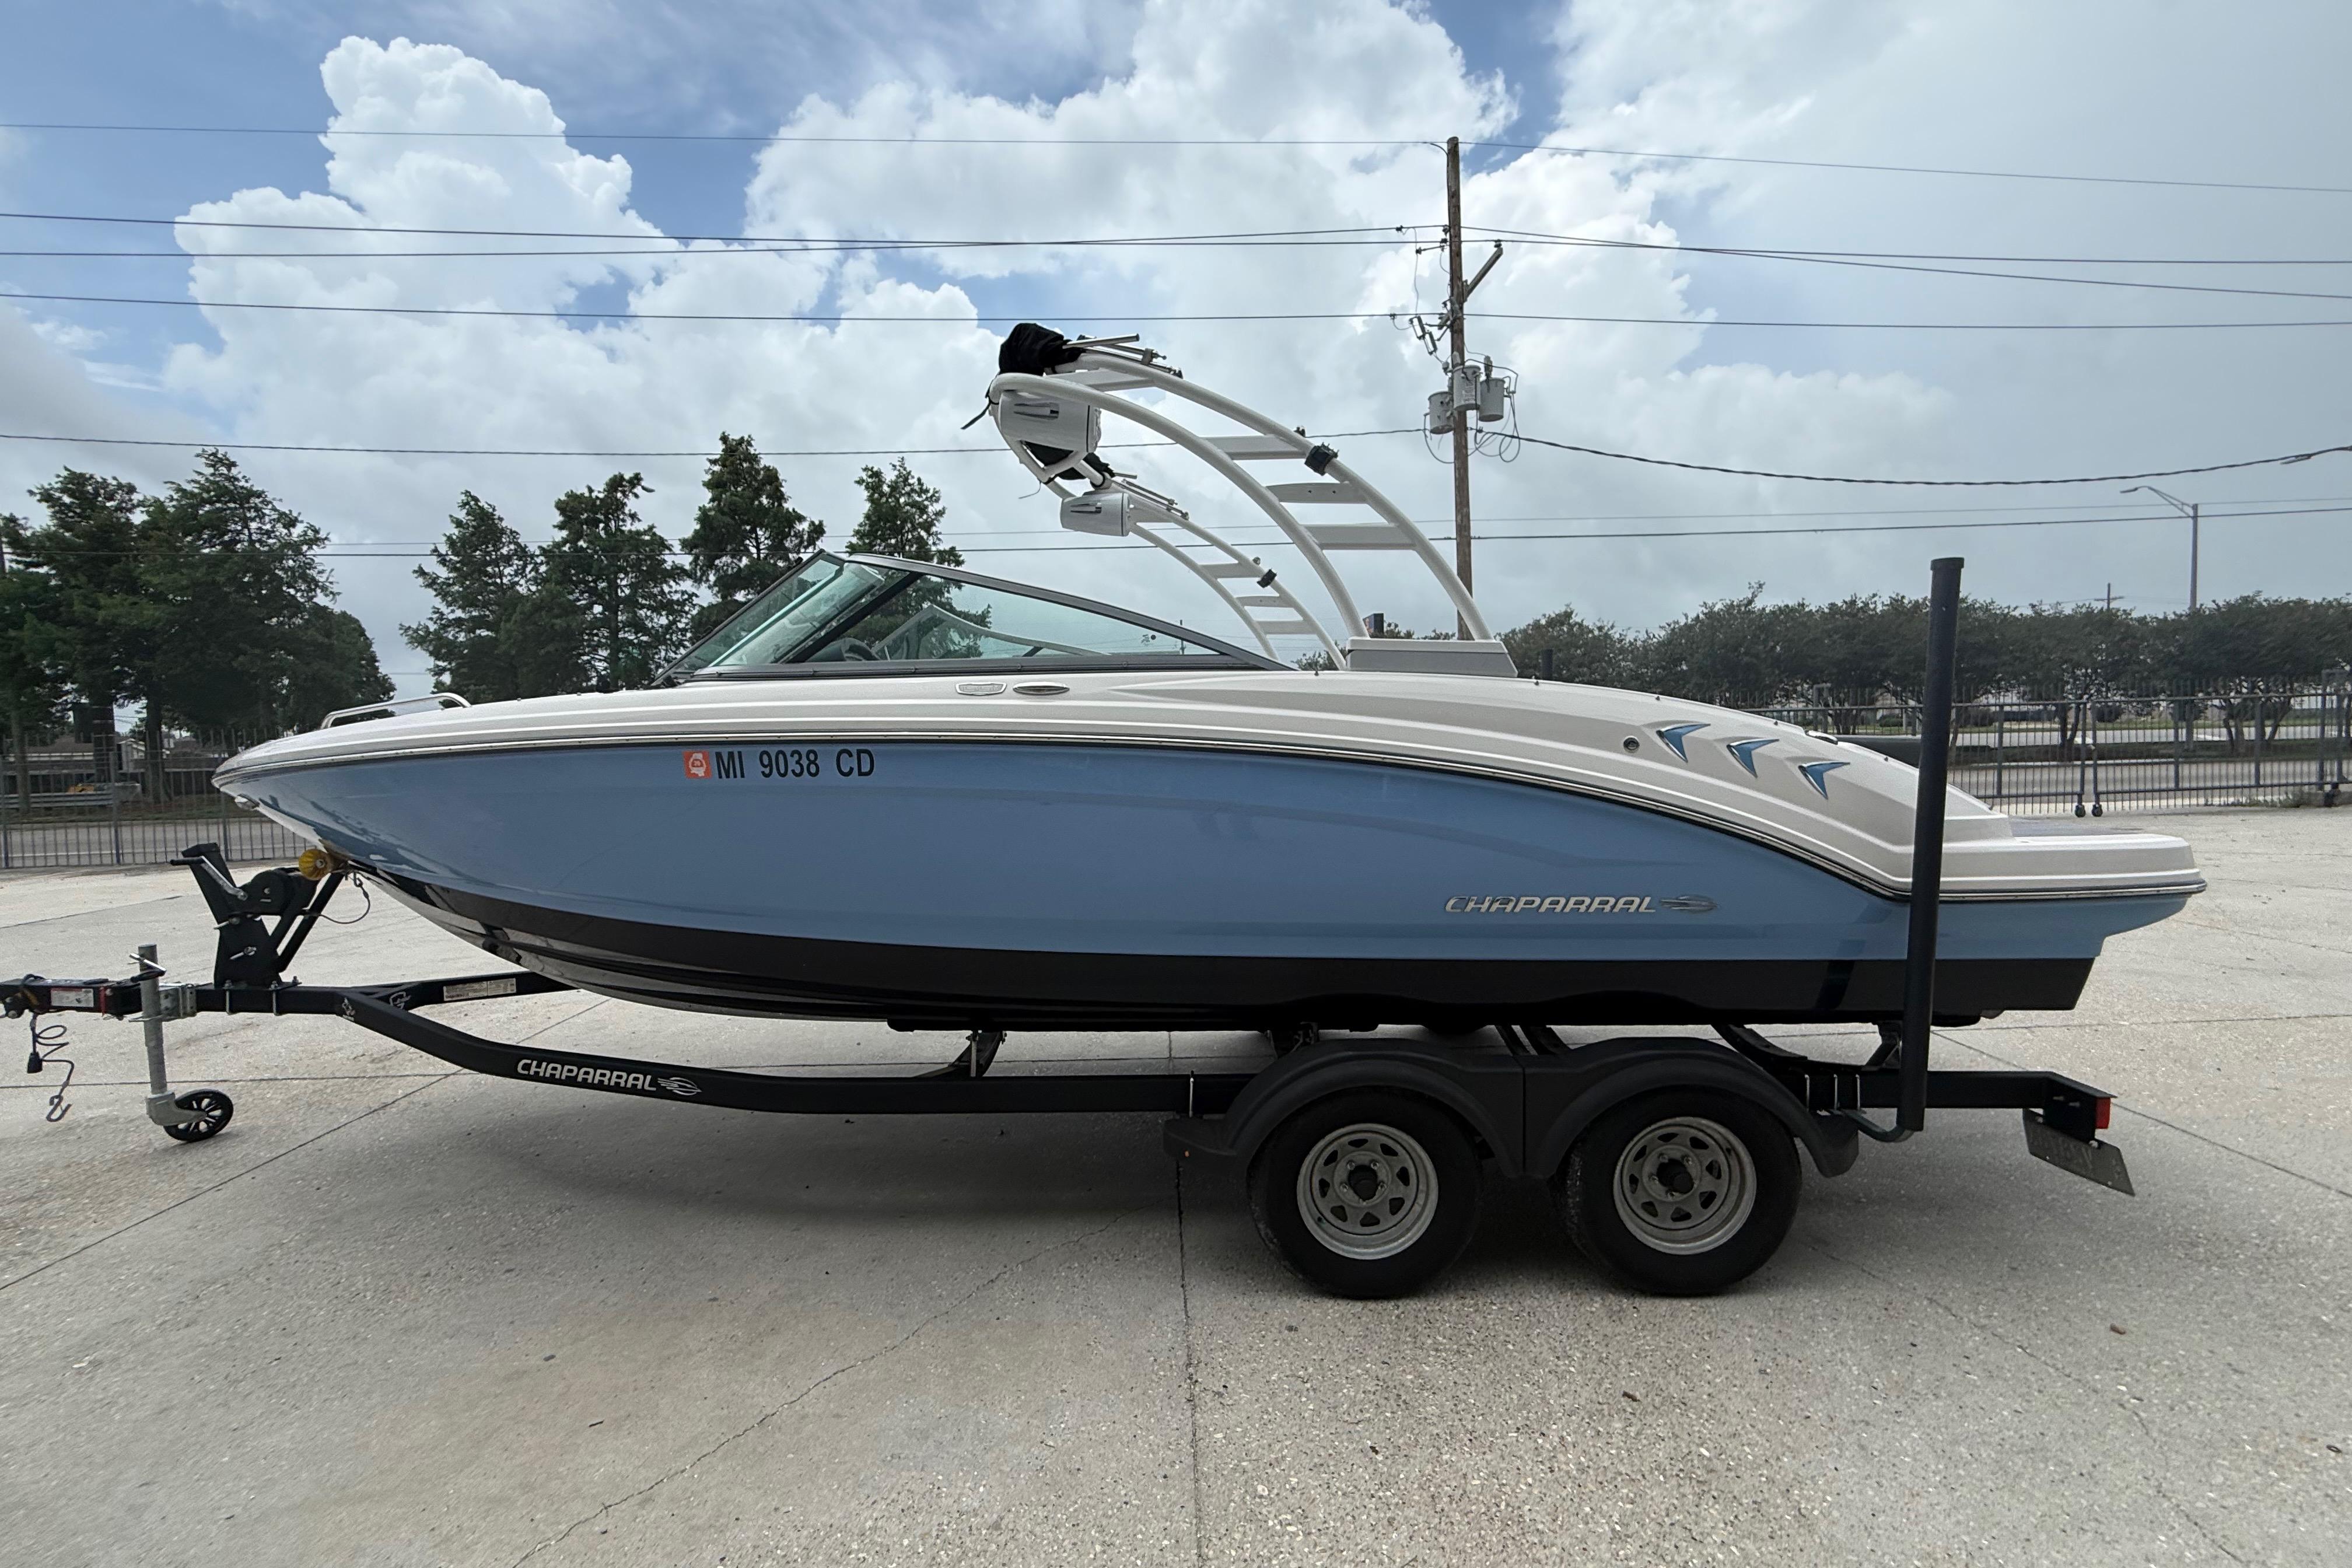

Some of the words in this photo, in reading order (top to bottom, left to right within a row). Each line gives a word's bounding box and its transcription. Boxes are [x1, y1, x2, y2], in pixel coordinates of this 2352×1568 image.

[715, 751, 746, 779] MI
[759, 749, 820, 778] 9038
[836, 748, 875, 777] CD
[1445, 896, 1656, 913] CHAPARRAL
[517, 1059, 657, 1091] CHAPARRAL
